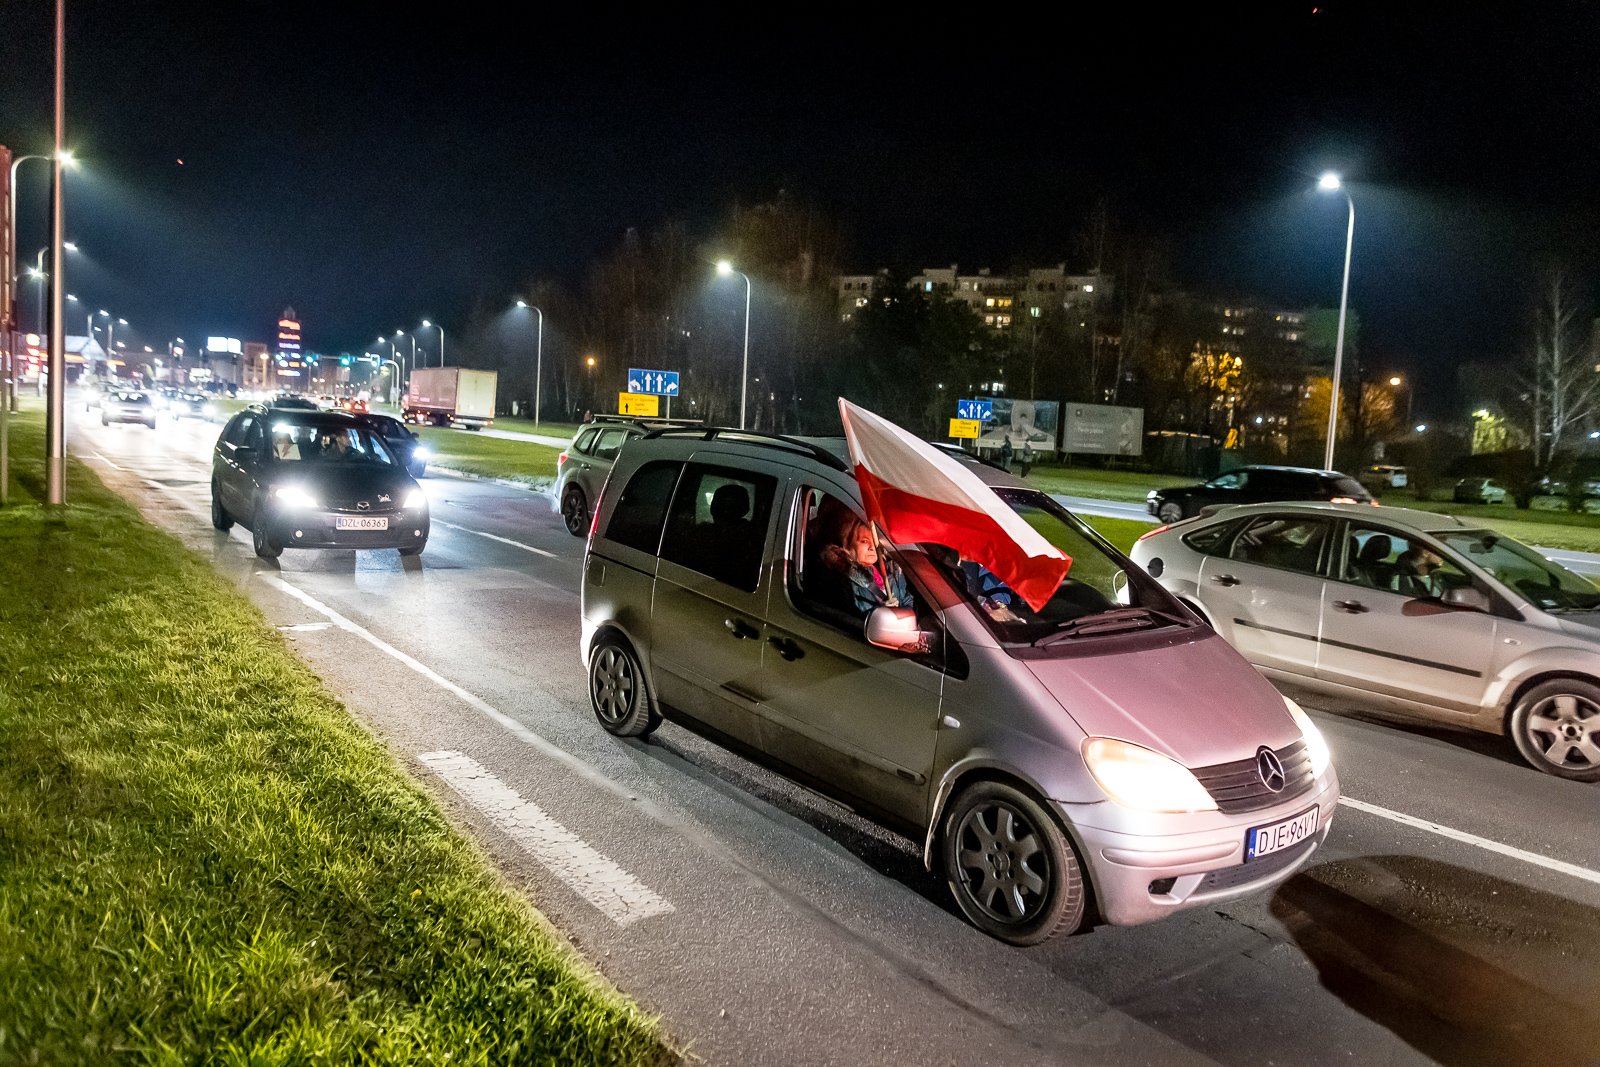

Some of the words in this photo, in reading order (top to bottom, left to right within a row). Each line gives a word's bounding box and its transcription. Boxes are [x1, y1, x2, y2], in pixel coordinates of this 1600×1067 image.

[342, 518, 358, 528] DZL
[361, 519, 386, 528] 06363
[1258, 825, 1287, 854] DJE
[1290, 811, 1315, 844] 96V1
